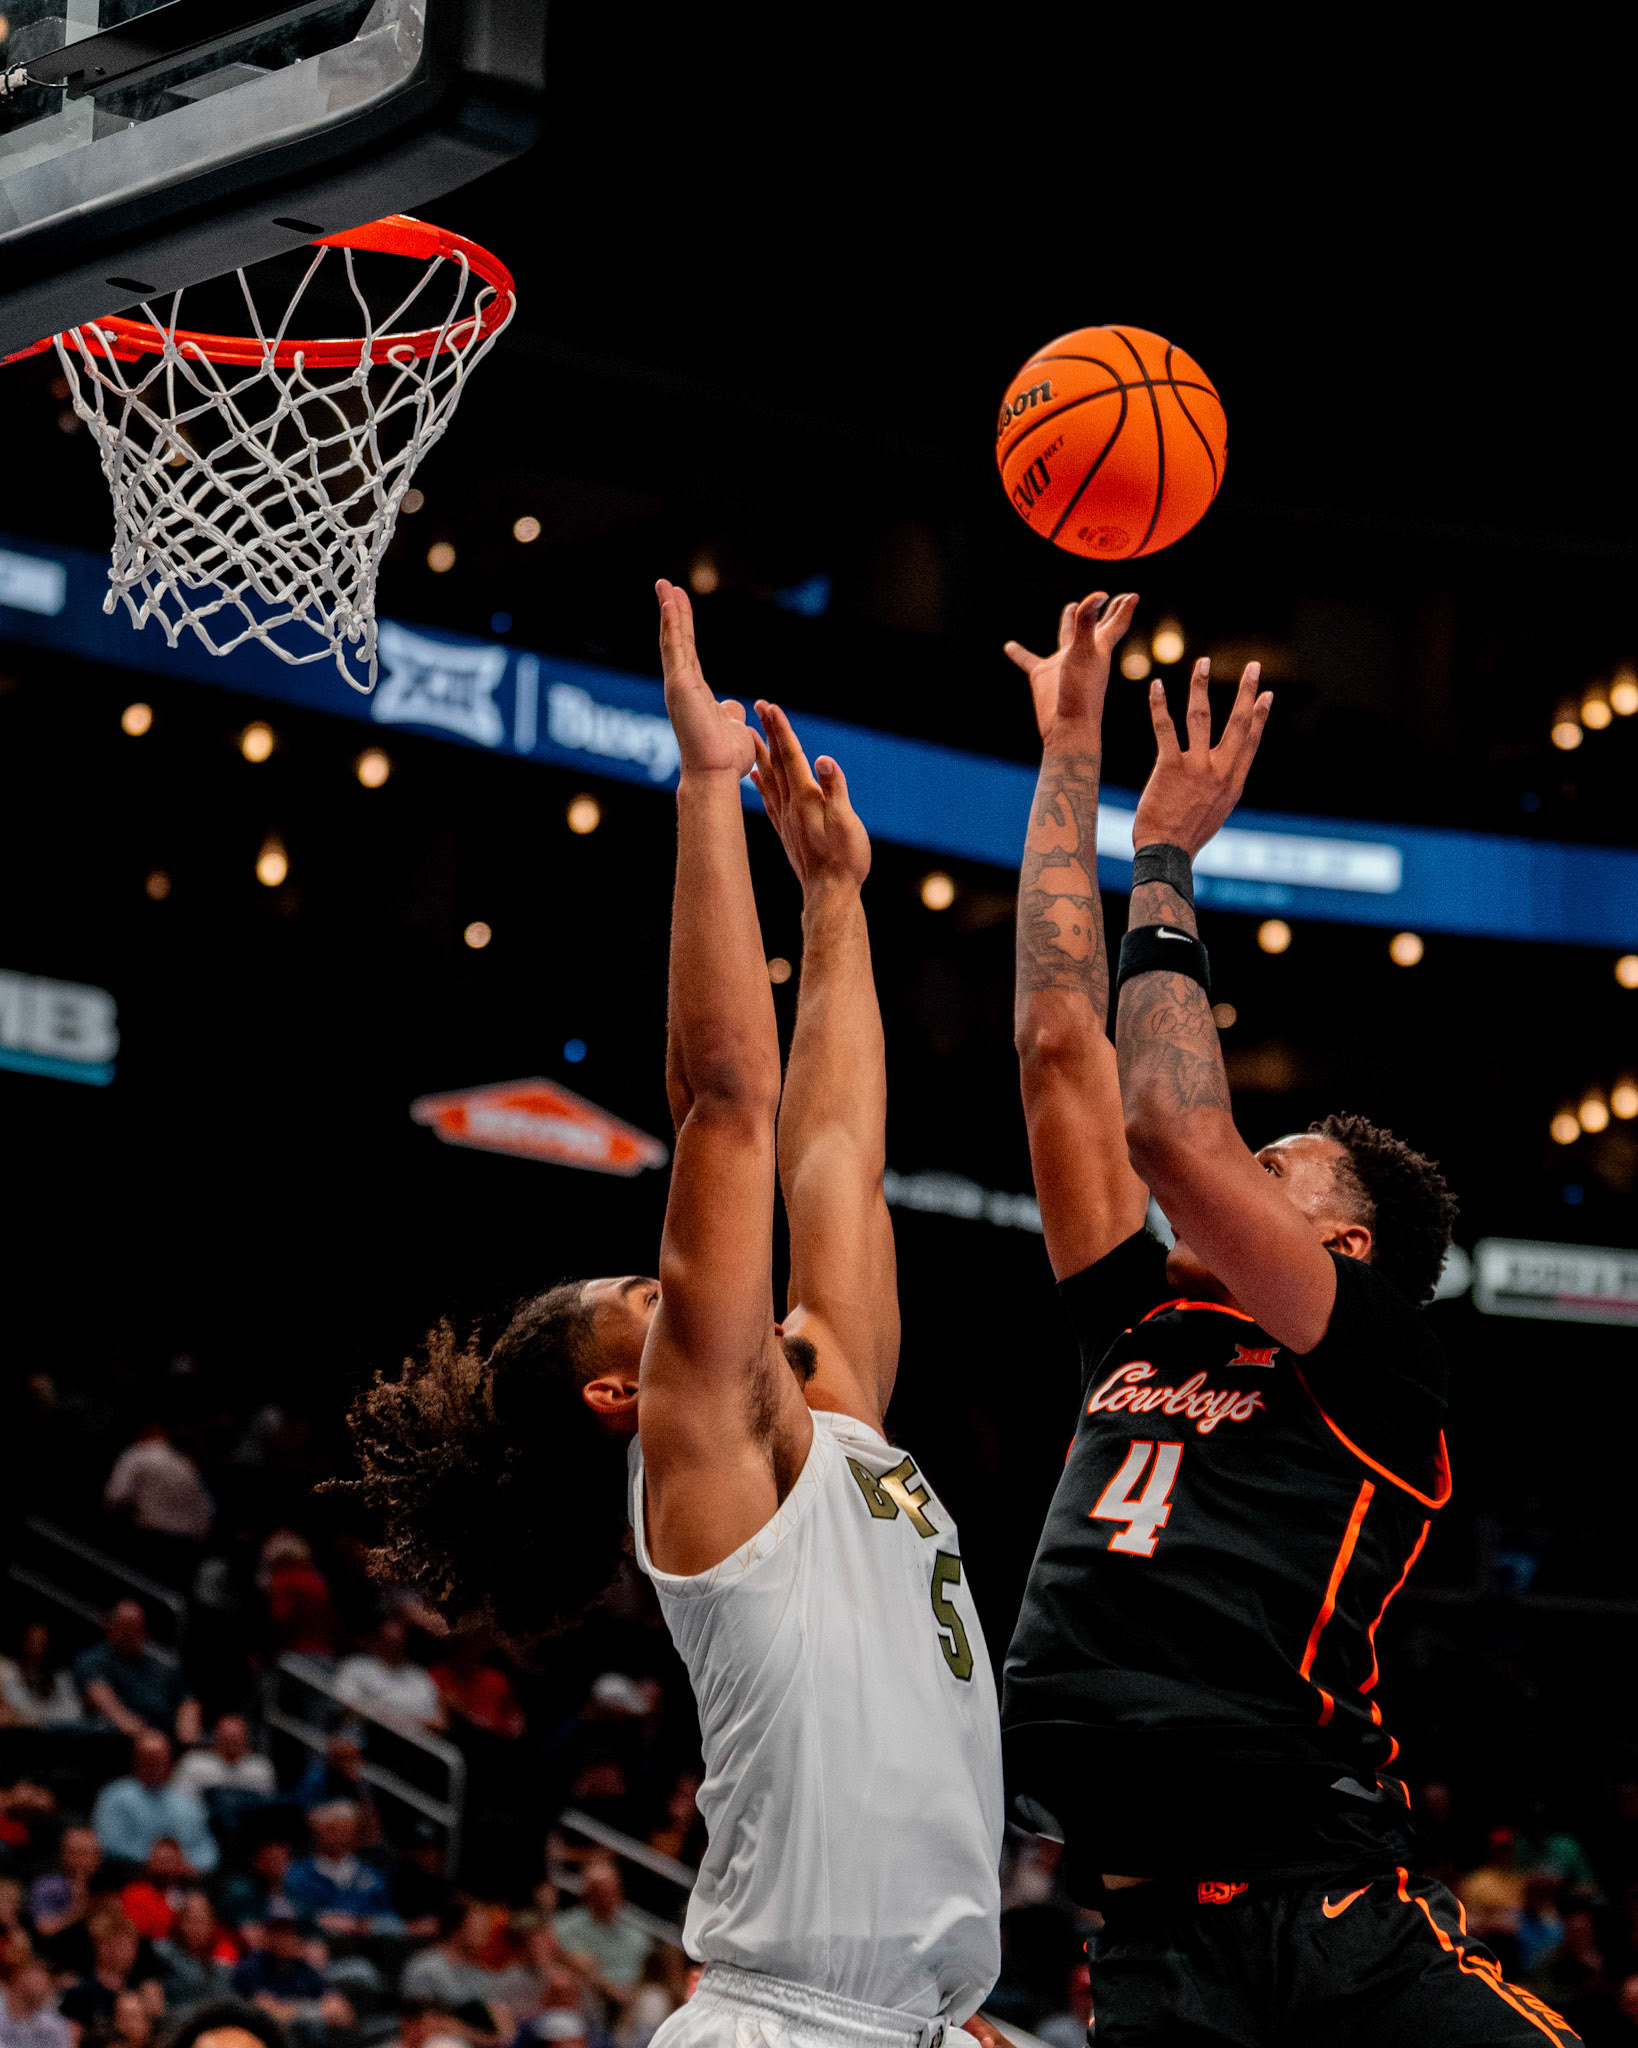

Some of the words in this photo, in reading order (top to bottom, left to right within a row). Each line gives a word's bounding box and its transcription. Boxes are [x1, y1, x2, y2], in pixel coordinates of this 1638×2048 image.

[1043, 435, 1065, 461] NXT
[1087, 1360, 1266, 1434] Cowboys
[1088, 1440, 1184, 1558] 4
[930, 1549, 974, 1682] 5
